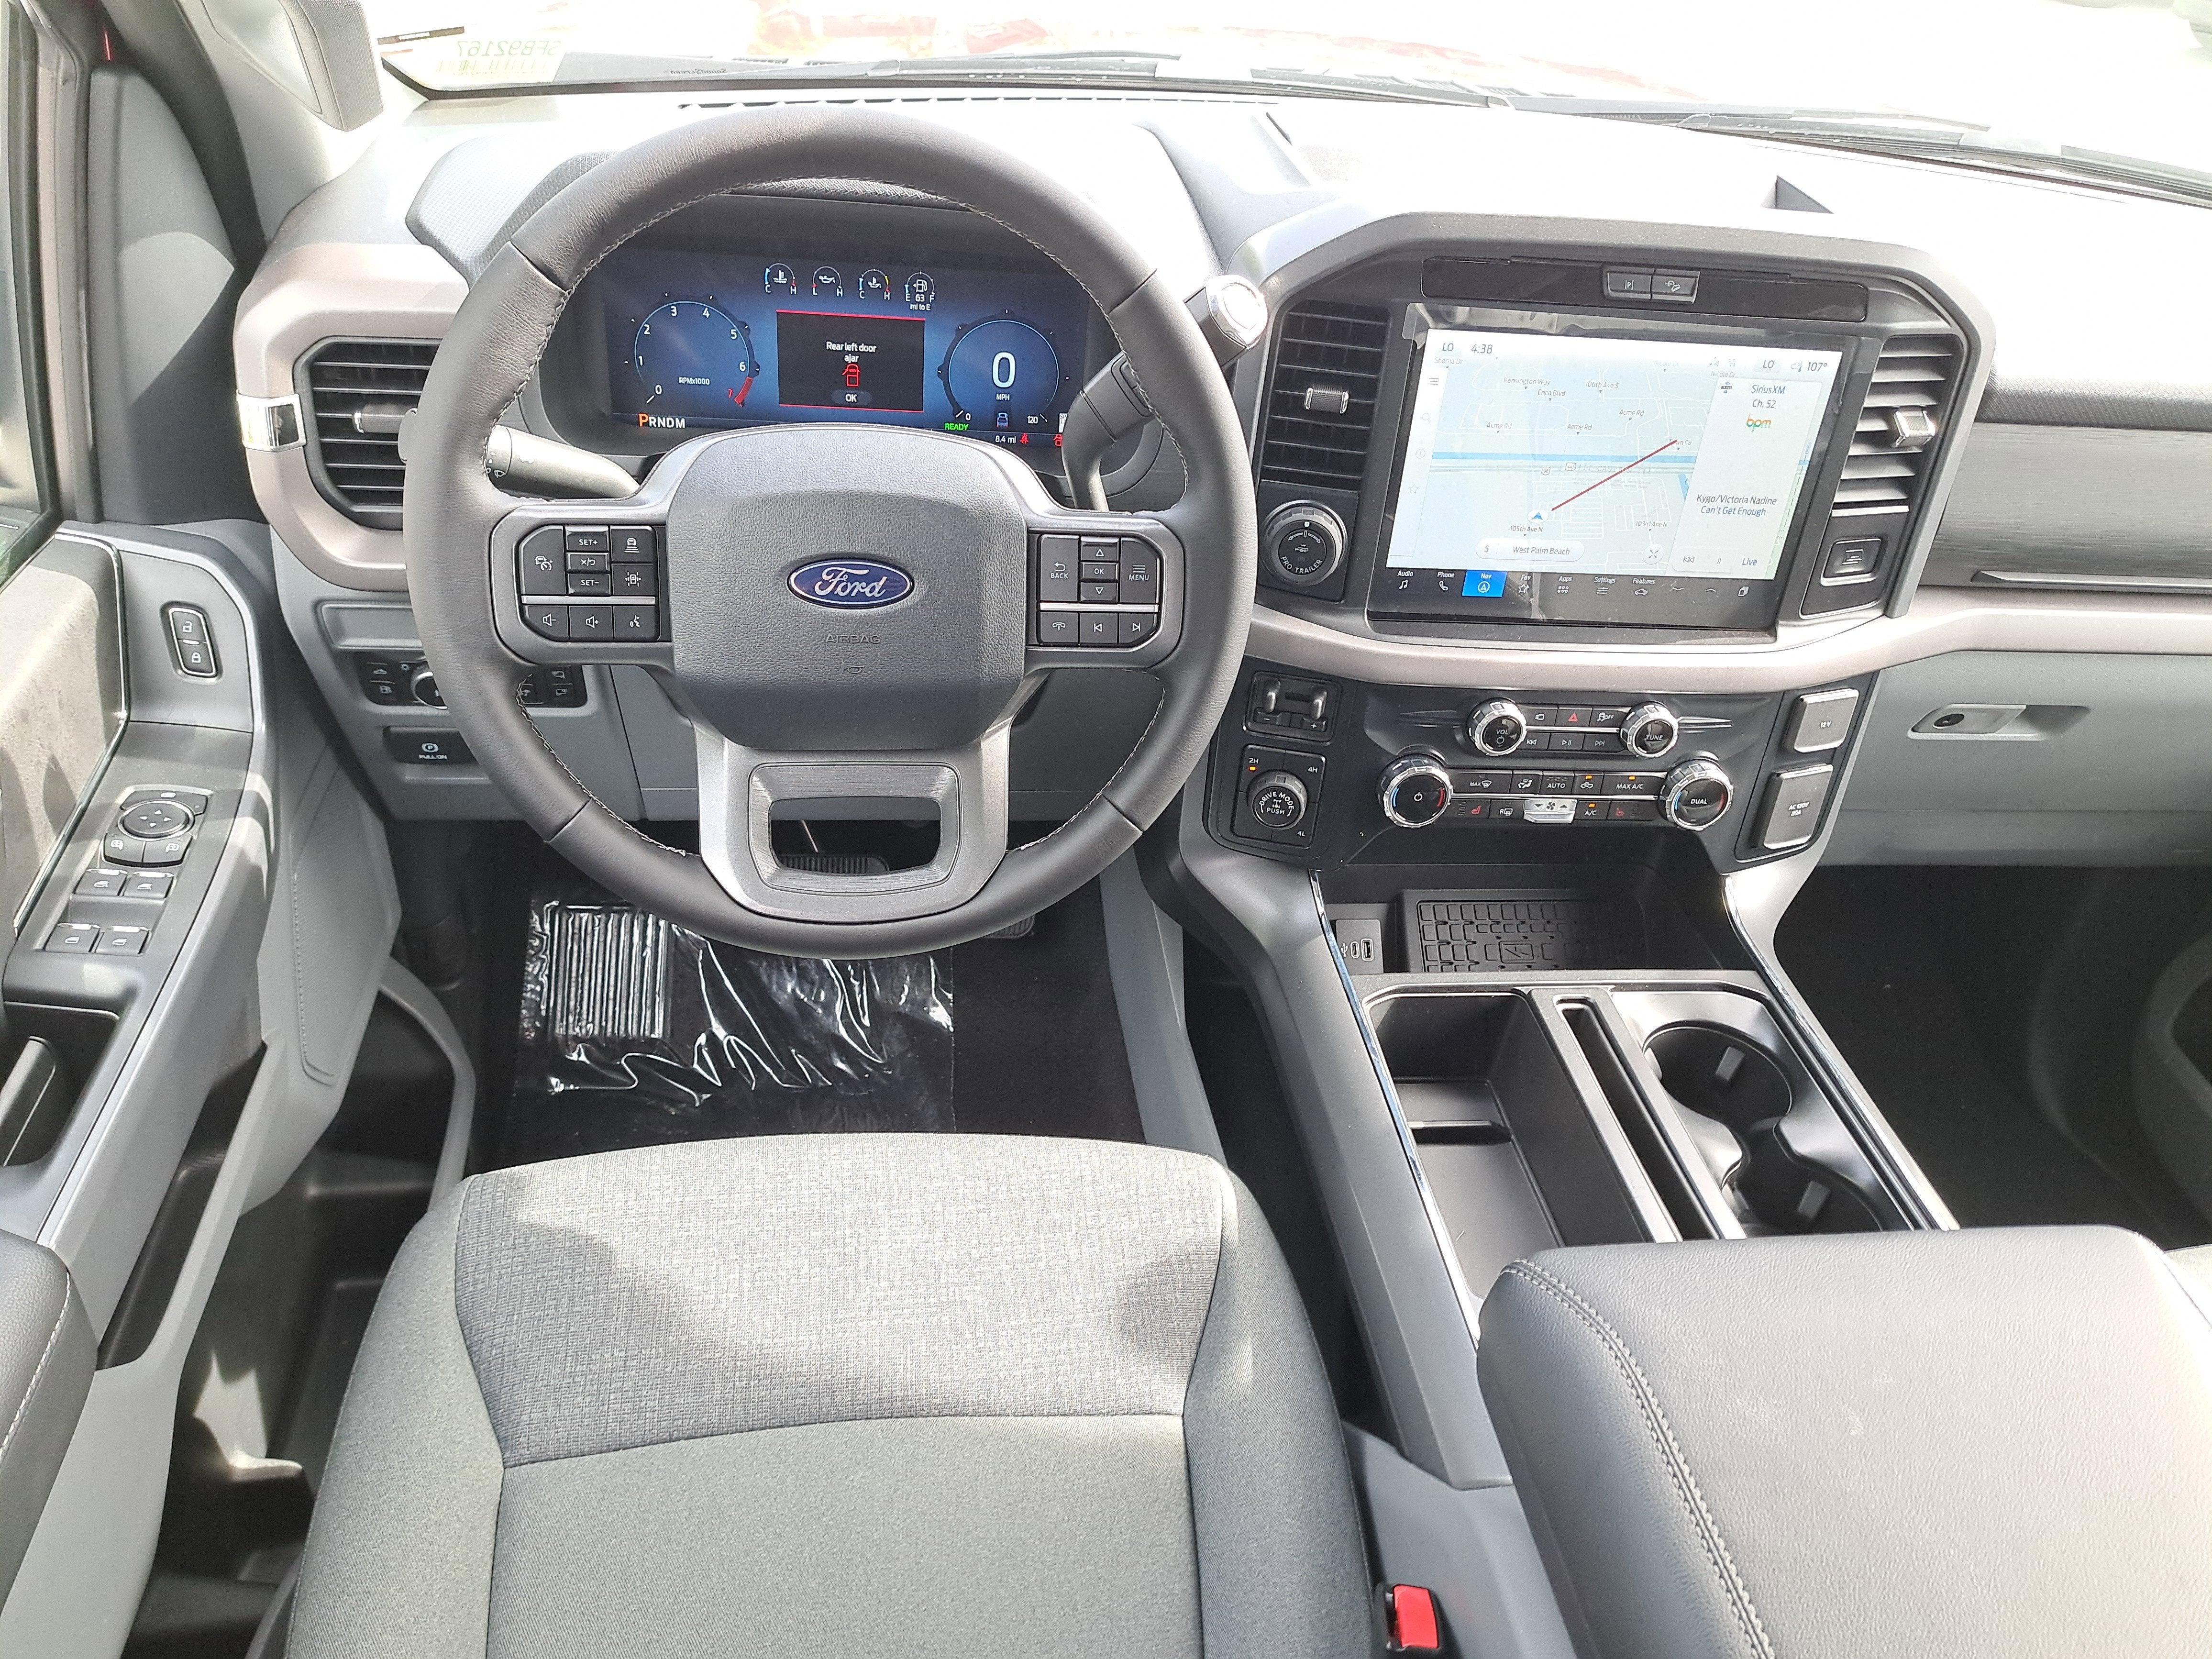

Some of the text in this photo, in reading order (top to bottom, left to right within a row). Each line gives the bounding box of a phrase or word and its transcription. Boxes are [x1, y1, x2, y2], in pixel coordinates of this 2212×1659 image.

[765, 285, 771, 293] C
[790, 286, 797, 295] H
[813, 287, 818, 296] L
[837, 288, 843, 297] H
[859, 290, 865, 299] C
[884, 292, 890, 300] H
[906, 293, 935, 303] E 63 F
[670, 306, 677, 316] 3
[702, 307, 709, 318] 4
[643, 324, 651, 335] 2
[730, 329, 737, 339] 5
[826, 341, 877, 353] Rear left door
[1442, 343, 1454, 352] LO
[1471, 343, 1493, 354] 4:38
[638, 355, 643, 365] 1
[844, 354, 859, 364] ajar
[739, 362, 746, 372] 6
[1763, 360, 1774, 368] LO
[992, 352, 1016, 388] 0
[679, 376, 710, 385] RPMx1000
[1504, 377, 1537, 386] Kensington
[654, 385, 663, 394] 0
[728, 389, 733, 398] 7
[845, 394, 857, 403] OK
[1752, 399, 1777, 408] Ch. 52
[1027, 416, 1038, 424] 120
[995, 435, 1006, 443] 8.4
[1696, 494, 1777, 505] Kygo/Victoria Nadine
[1701, 506, 1766, 517] Can't Get Enough
[1281, 556, 1323, 574] PRO TRAILER
[814, 567, 887, 598] Ford
[826, 635, 881, 644] AIRBAG
[1259, 791, 1294, 809] DRIVE MODE
